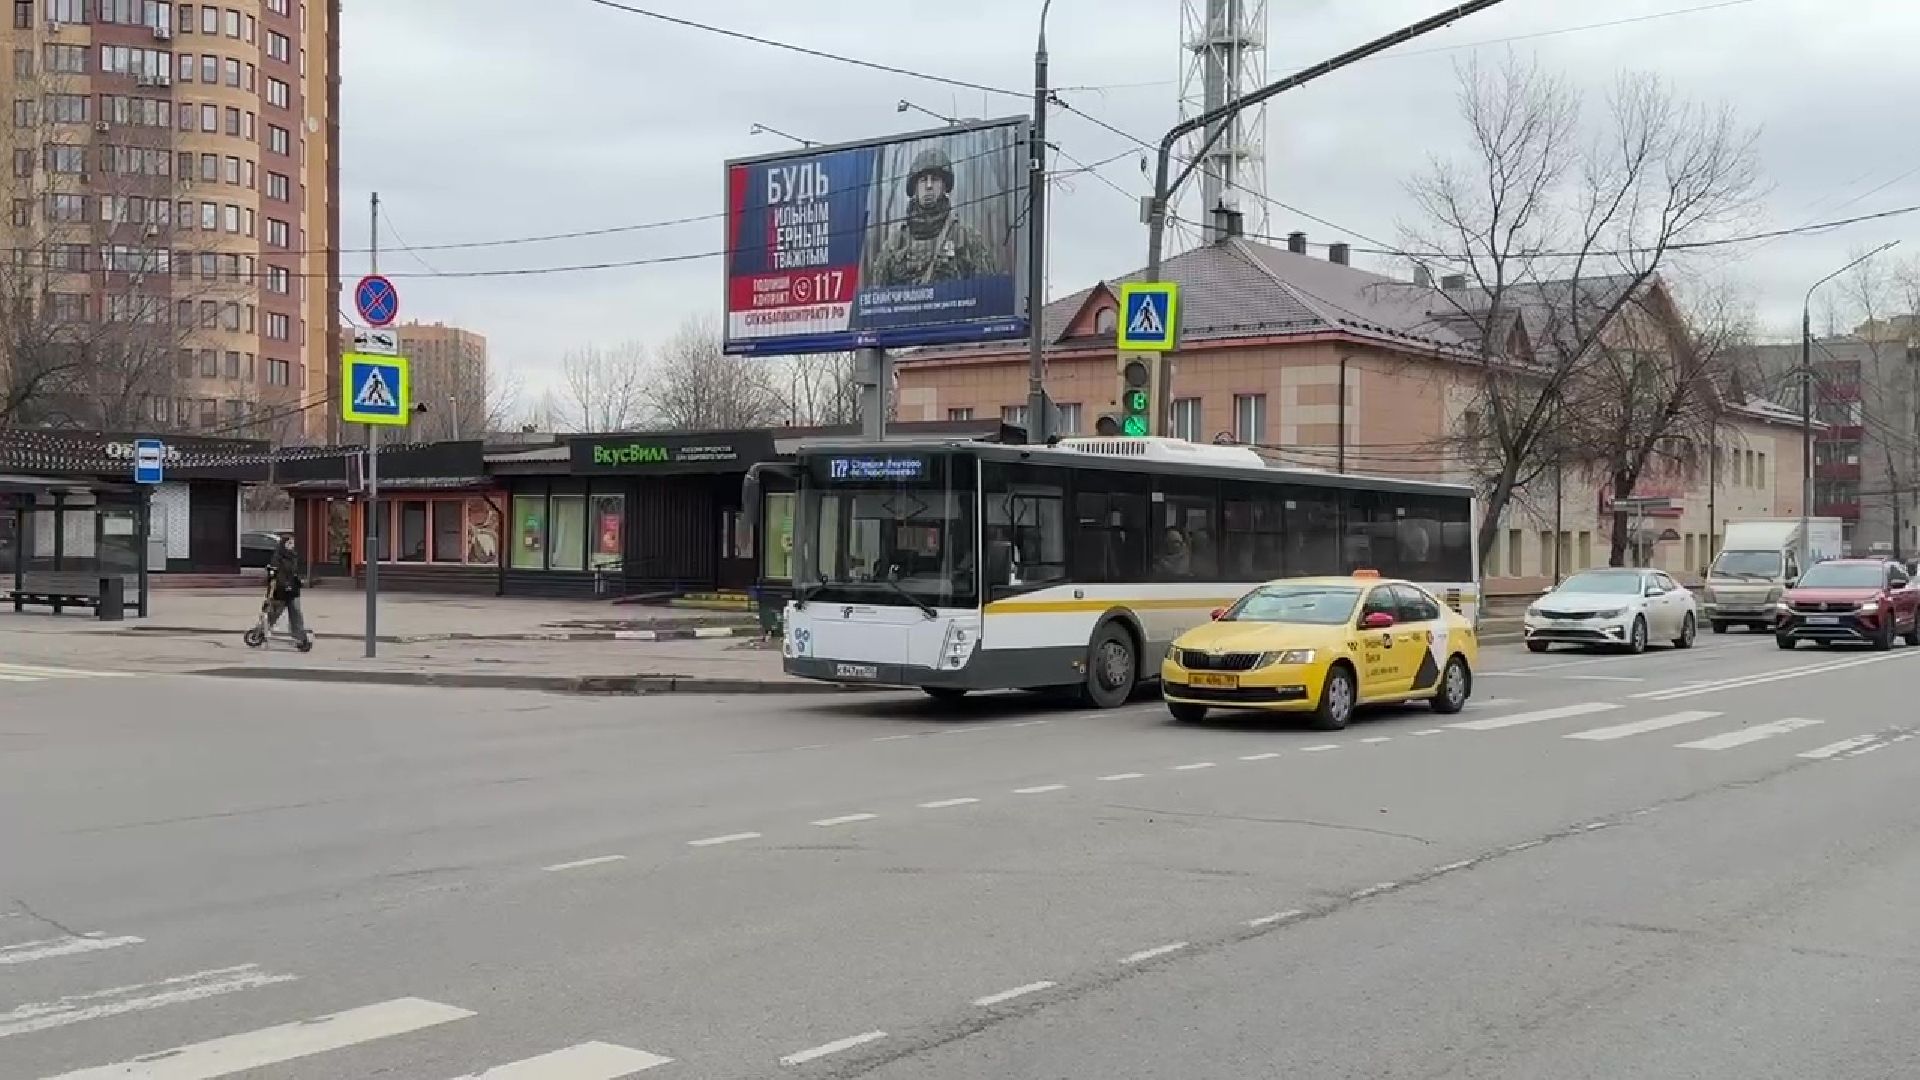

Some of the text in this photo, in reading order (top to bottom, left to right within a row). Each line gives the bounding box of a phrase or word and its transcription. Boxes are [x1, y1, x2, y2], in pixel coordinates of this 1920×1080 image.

[767, 162, 829, 205] БУДЬ
[768, 202, 829, 230] ИЛЬНЫМ
[768, 223, 829, 251] ЕРНЫМ
[768, 247, 829, 270] ТВАЖНЫМ
[813, 271, 844, 301] 117
[106, 442, 182, 461] ОБЬ
[593, 444, 668, 467] ВкусВилл
